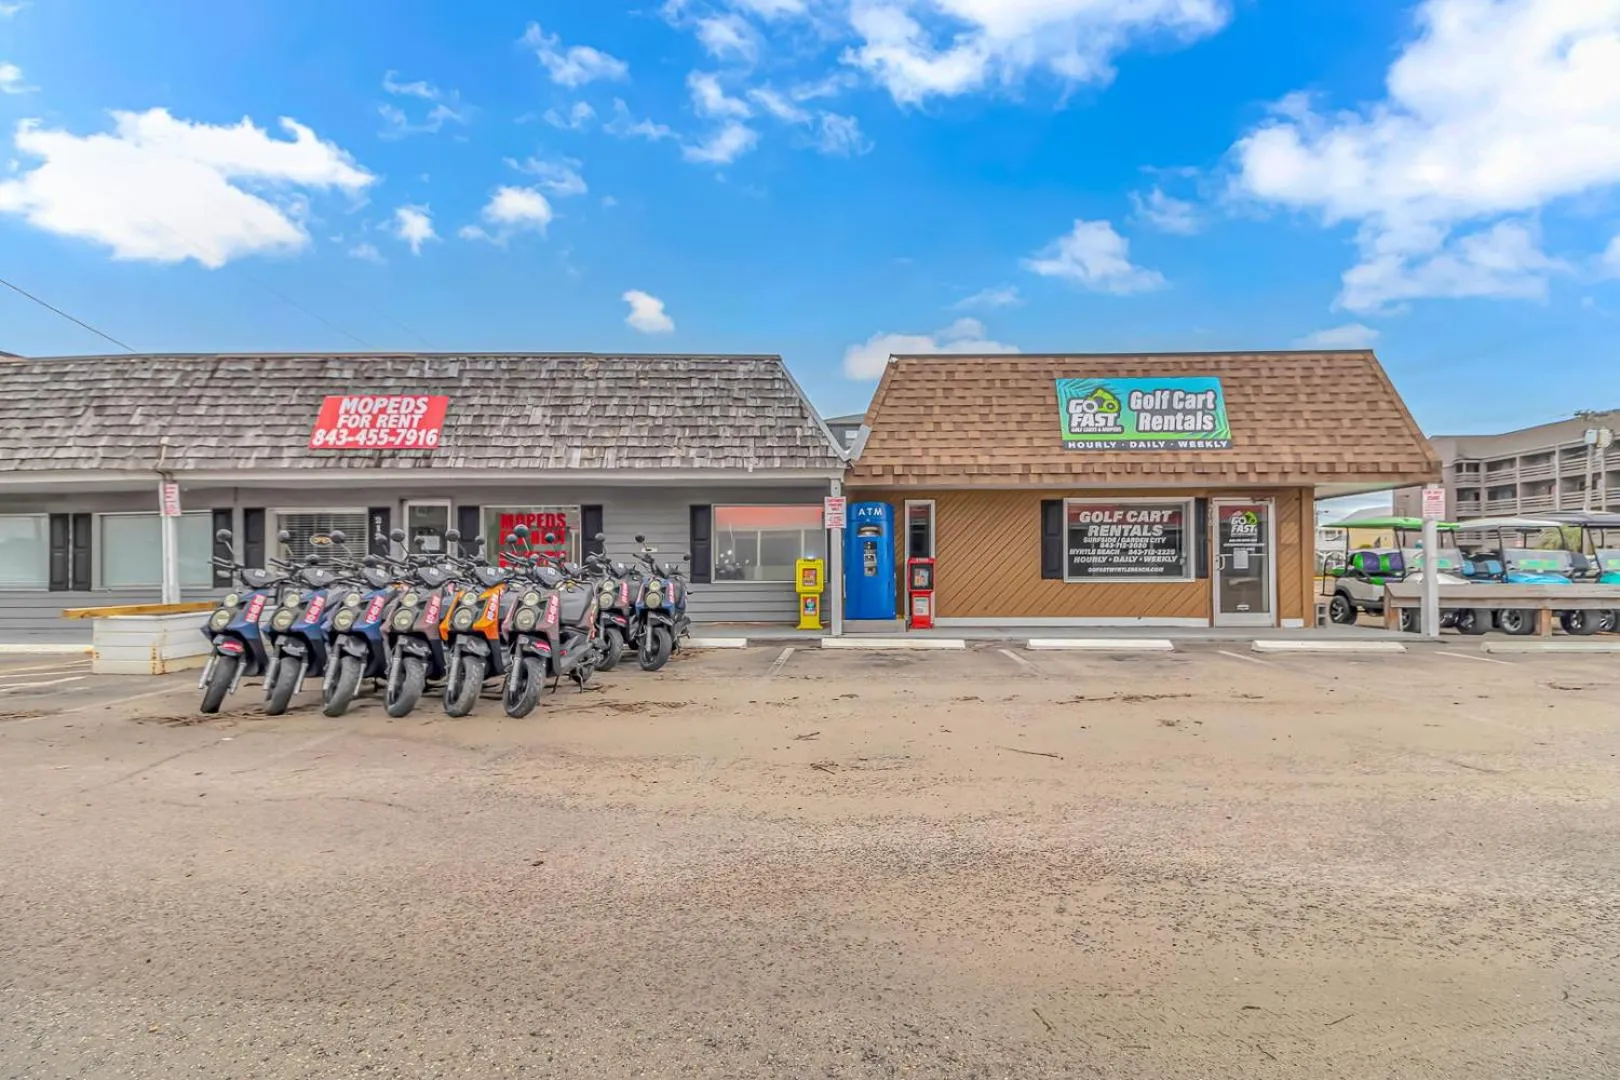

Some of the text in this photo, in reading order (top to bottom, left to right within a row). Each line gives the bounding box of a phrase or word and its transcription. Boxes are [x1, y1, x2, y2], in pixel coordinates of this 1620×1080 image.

[339, 396, 430, 415] MOPEDS
[1068, 399, 1098, 413] GO
[1130, 390, 1216, 410] Golf Cart
[336, 414, 424, 429] FOR RENT
[1070, 412, 1118, 427] FAST
[1138, 411, 1214, 431] Rentals
[311, 428, 440, 446] 843-455-7916
[1067, 439, 1228, 449] HOURLY DAILY WEEKLY
[858, 507, 884, 516] ATM
[1079, 510, 1173, 523] GOLF CART
[1087, 524, 1164, 537] RENTALS
[1073, 555, 1178, 563] HOURLY DAILY WEEKLY
